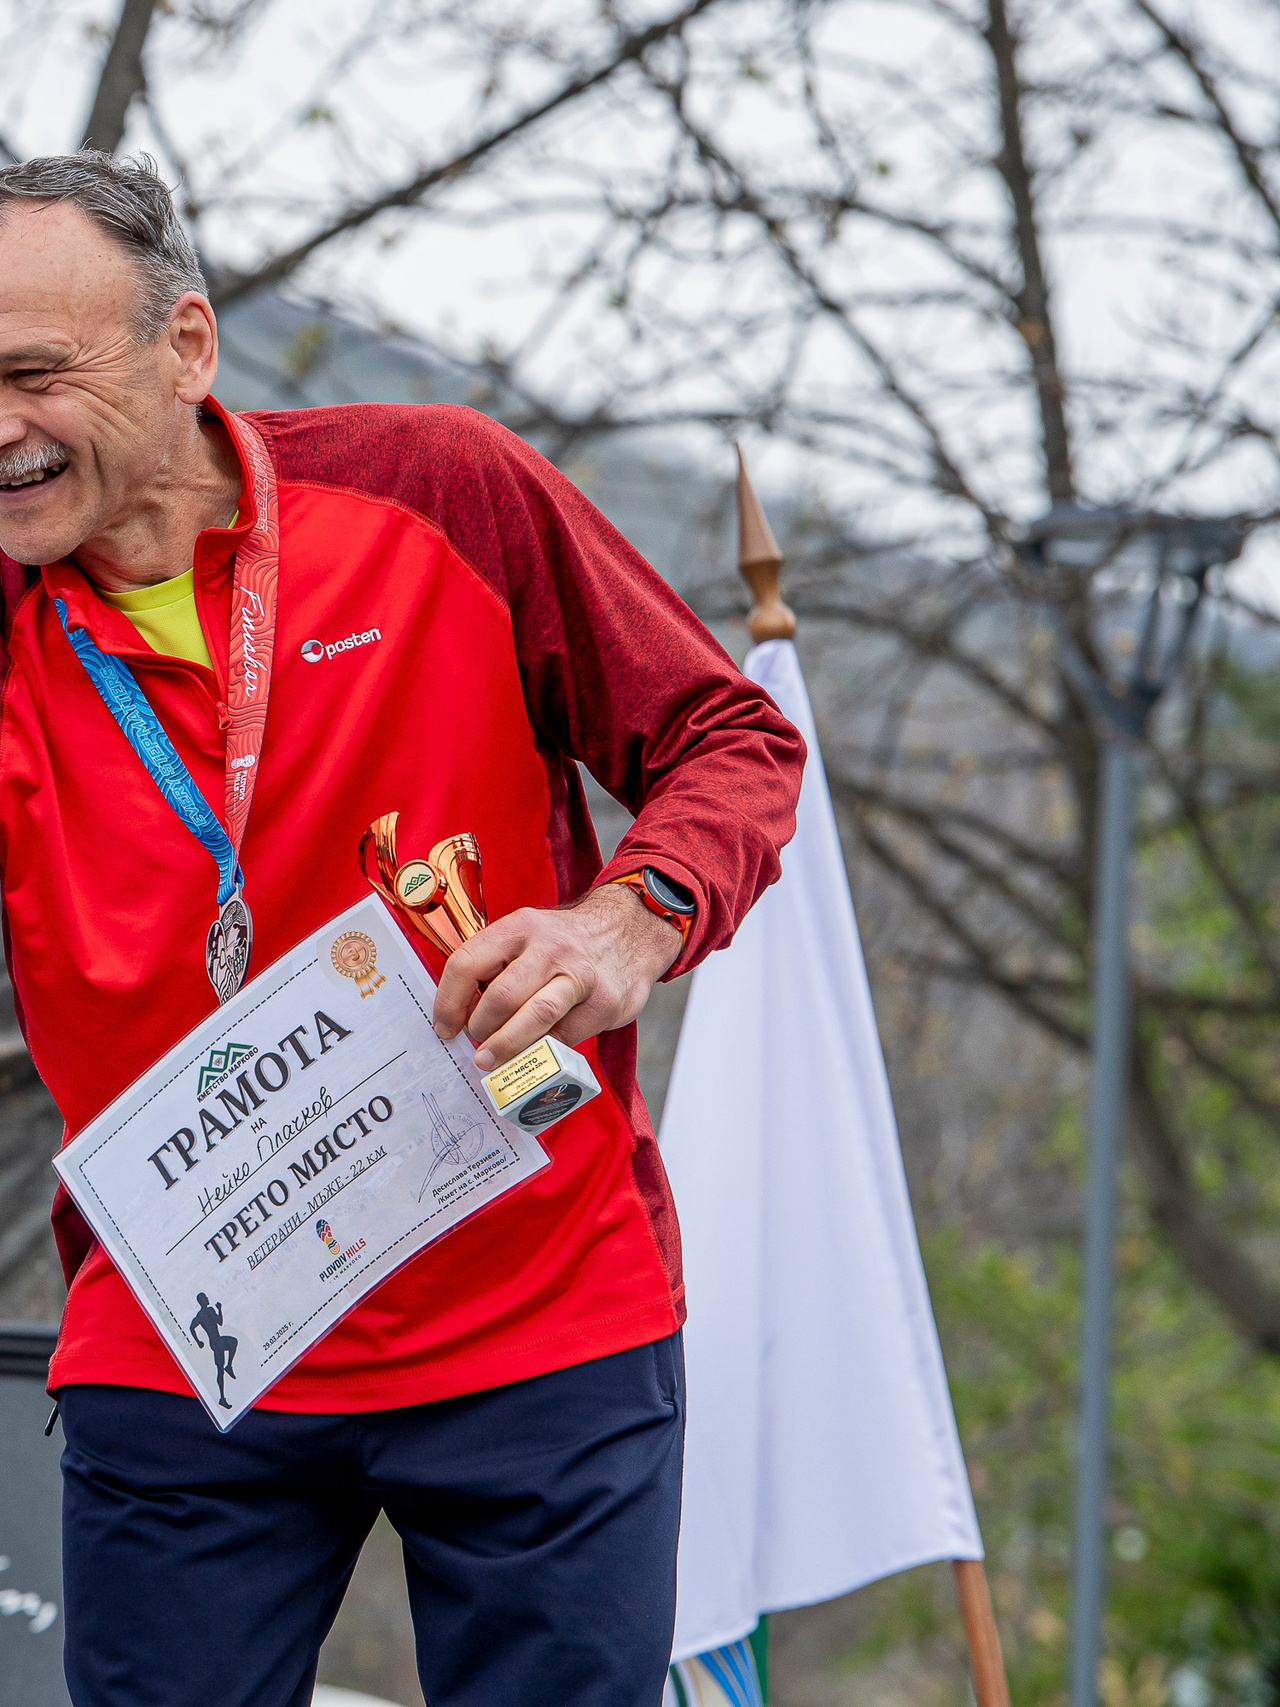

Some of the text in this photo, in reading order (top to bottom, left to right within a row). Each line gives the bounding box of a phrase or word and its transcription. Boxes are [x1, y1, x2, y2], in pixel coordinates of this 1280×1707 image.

[240, 586, 267, 698] Finisher
[325, 627, 382, 660] posten
[100, 665, 207, 827] EVERY STEP MATTERS
[196, 1046, 259, 1104] КМЕТСТВО МАРКОВО
[514, 1057, 538, 1076] МЯСТО
[147, 1010, 352, 1191] ГРАМОТА
[250, 1117, 268, 1134] НА
[197, 1086, 332, 1216] Нейко Плачков
[432, 1148, 501, 1197] Десислава Терзиева
[204, 1179, 290, 1263] ТРЕТО
[287, 1095, 394, 1189] МЯСТО
[437, 1187, 458, 1205] /Кмет
[458, 1182, 468, 1191] на
[473, 1155, 507, 1180] Марково/
[246, 1211, 302, 1271] ВЕТЕРАНИ
[307, 1176, 345, 1215] МЪЖЕ
[350, 1159, 366, 1177] 22
[319, 1238, 367, 1283] PLOVDIV HILLS
[263, 1325, 289, 1351] 29.03.2025
